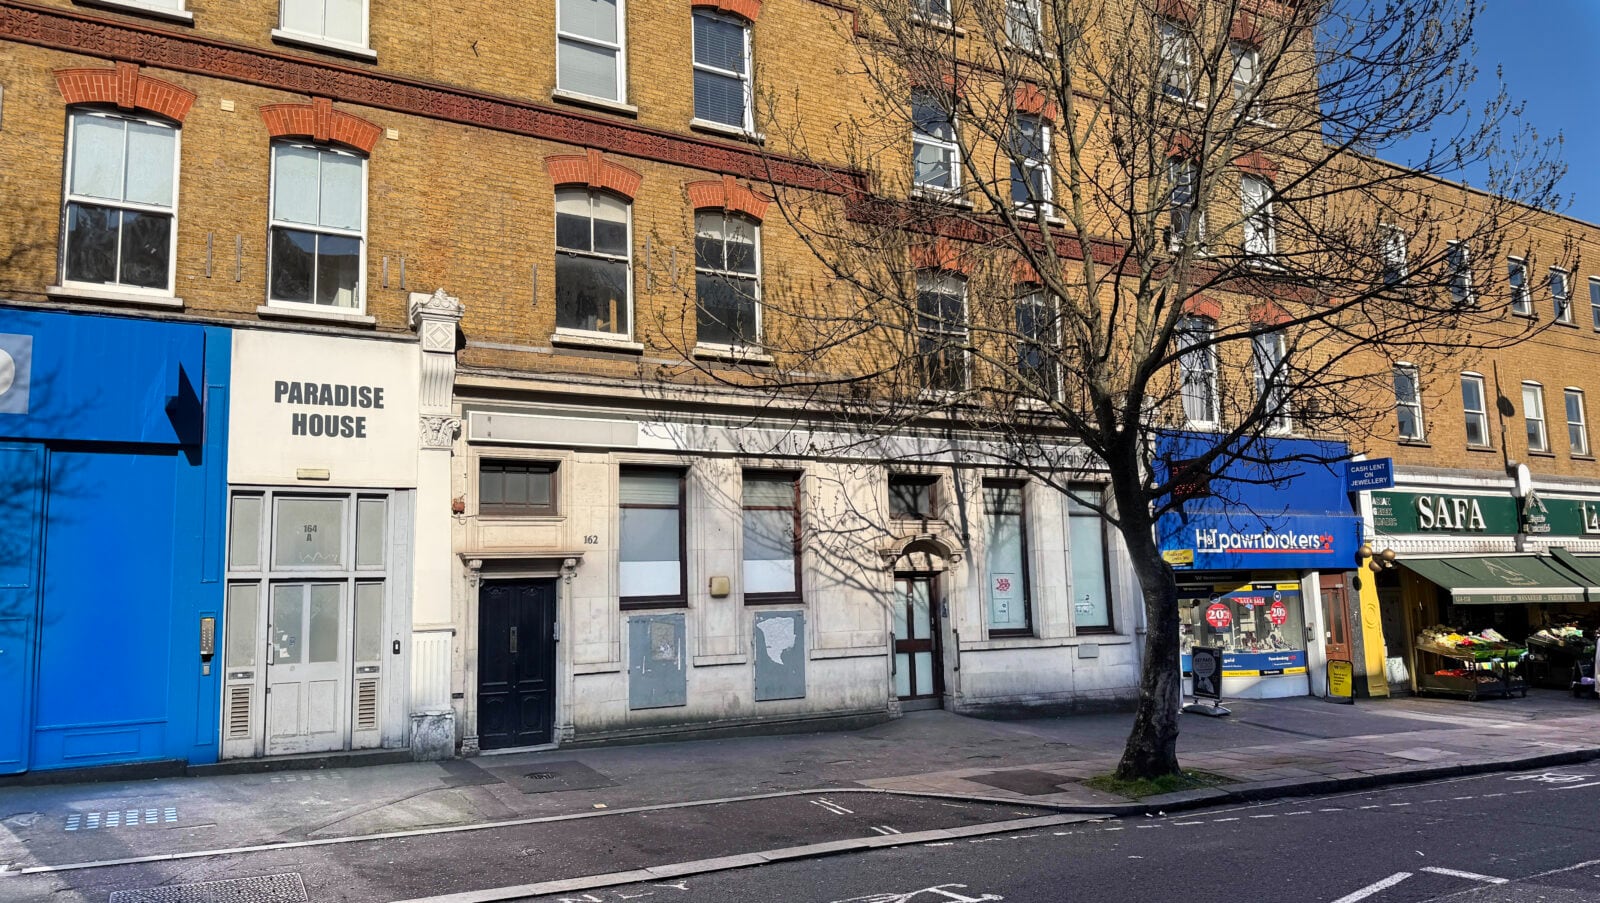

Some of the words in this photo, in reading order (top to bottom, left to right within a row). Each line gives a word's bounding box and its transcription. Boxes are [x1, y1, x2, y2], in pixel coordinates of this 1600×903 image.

[274, 380, 384, 409] PARADISE
[292, 412, 367, 439] HOUSE
[1350, 465, 1369, 473] CASH
[1369, 463, 1386, 471] LENT
[1351, 477, 1388, 487] JEWELLERY
[1418, 495, 1488, 530] SAFA
[303, 524, 318, 533] 164
[306, 533, 313, 542] A
[583, 535, 599, 545] 162
[1195, 528, 1218, 550] H&T
[1219, 530, 1321, 553] pawnbrokers
